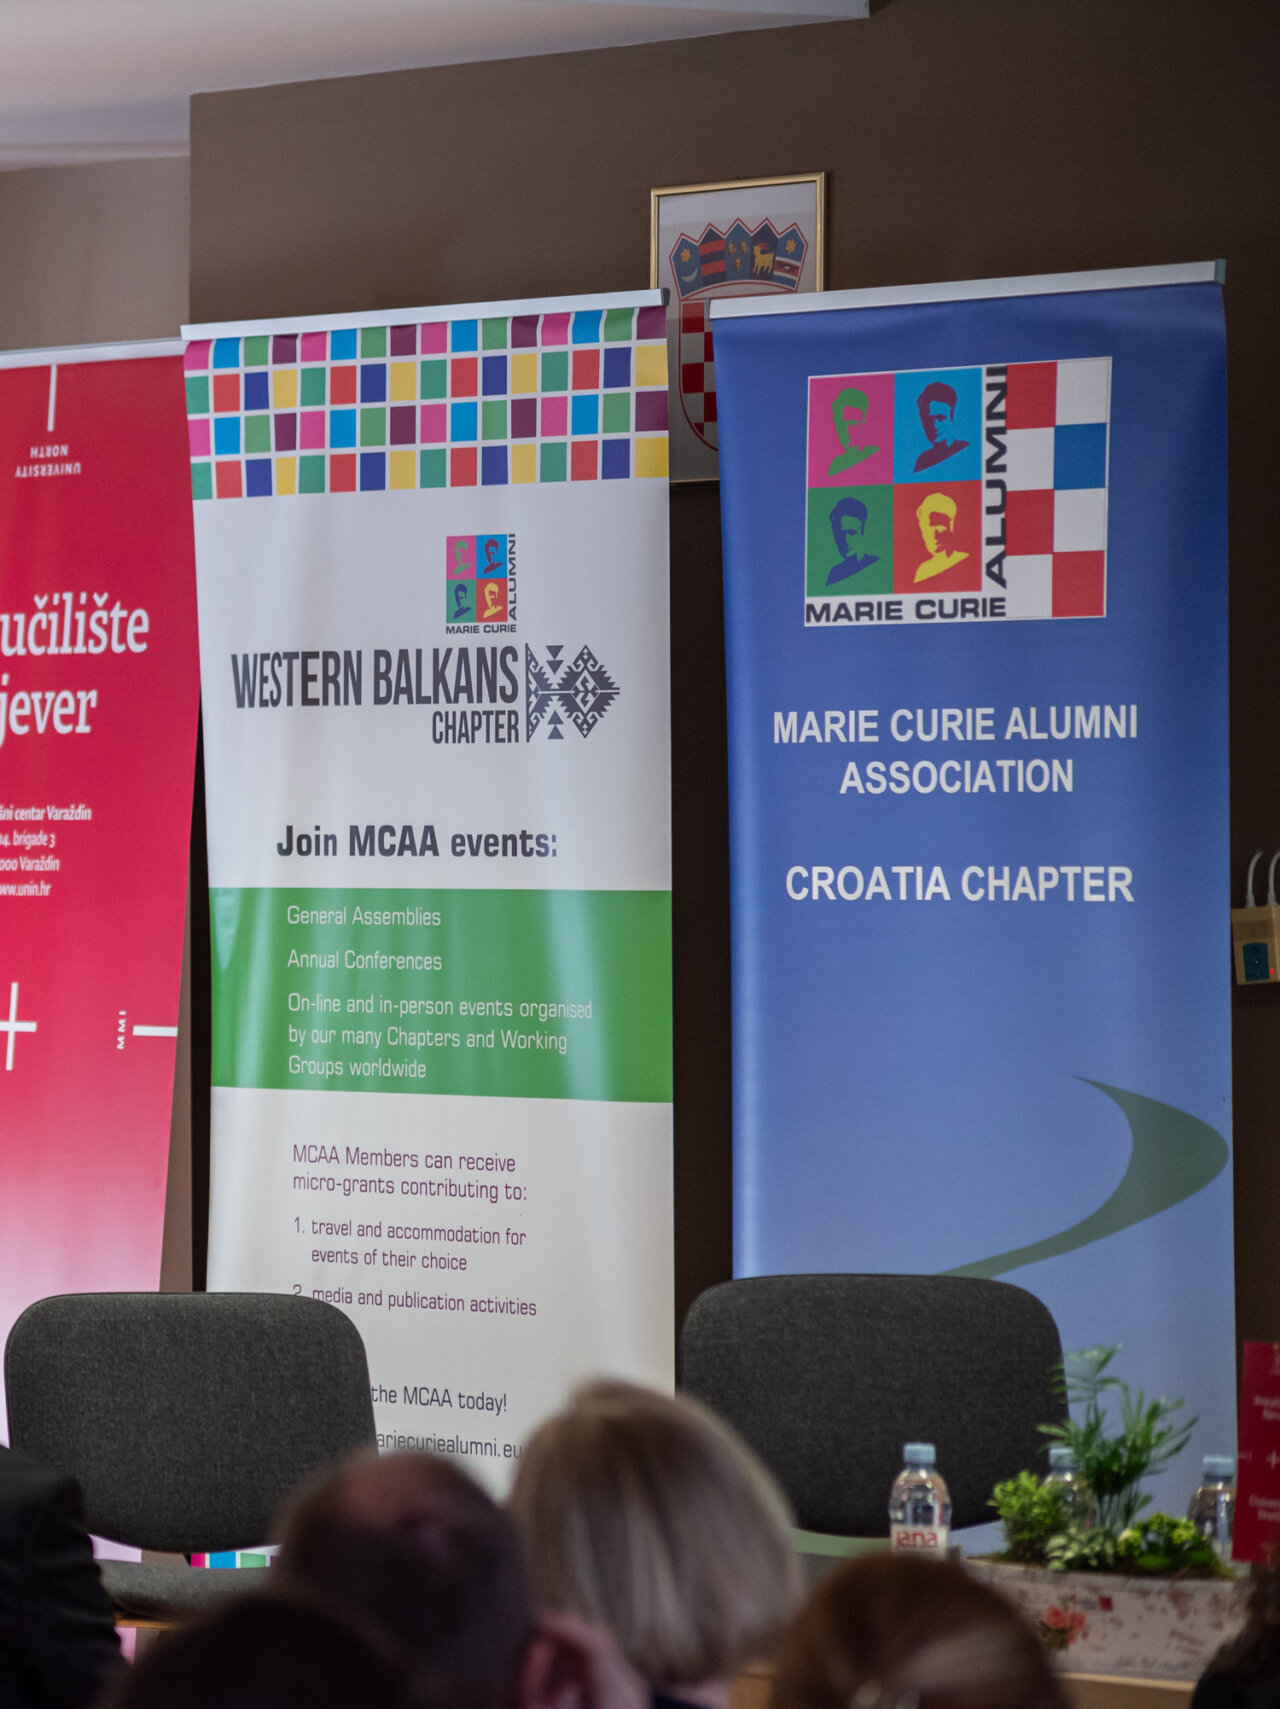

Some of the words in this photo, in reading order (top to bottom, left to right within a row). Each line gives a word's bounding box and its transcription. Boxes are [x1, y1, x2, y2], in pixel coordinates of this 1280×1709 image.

[30, 445, 68, 457] NORTH
[15, 462, 80, 476] UNIVERSITY
[985, 365, 1007, 587] ALUMNI
[508, 534, 516, 620] ALUMNI
[805, 600, 902, 622] MARIE
[914, 597, 1006, 619] CURIE
[446, 625, 479, 633] MARIE
[483, 624, 516, 632] CURIE
[231, 650, 362, 708] WESTERN
[373, 645, 518, 705] BALKANS
[432, 710, 519, 744] CHAPTER
[773, 710, 878, 742] MARIE
[890, 707, 995, 741] CURIE
[1004, 704, 1137, 740] ALUMNI
[839, 758, 1073, 794] ASSOCIATION
[14, 806, 45, 820] centar
[47, 804, 91, 820] Varaždin
[13, 830, 47, 849] brigade
[49, 833, 55, 847] 3
[276, 825, 337, 856] Join
[348, 825, 439, 856] MCAA
[450, 829, 557, 857] events:
[19, 855, 59, 870] Varaždin
[786, 865, 950, 900] CROATIA
[961, 865, 1134, 901] CHAPTER
[287, 905, 346, 924] General
[352, 906, 440, 925] Assemblies
[287, 949, 338, 968] Annual
[344, 950, 441, 970] Conferences
[288, 993, 340, 1011] On-line
[346, 994, 373, 1012] and
[380, 995, 452, 1017] in-person
[459, 1000, 512, 1016] events
[519, 999, 592, 1021] organised
[289, 1024, 305, 1046] by
[311, 1027, 335, 1043] our
[341, 1029, 381, 1048] many
[387, 1026, 460, 1050] Chapters
[466, 1029, 494, 1047] and
[501, 1030, 566, 1054] Working
[289, 1055, 343, 1078] Groups
[349, 1058, 425, 1077] worldwide
[293, 1144, 339, 1163] MCAA
[345, 1146, 418, 1167] Members
[424, 1153, 452, 1168] can
[458, 1153, 515, 1172] receive
[293, 1171, 394, 1196] micro-grants
[400, 1178, 498, 1203] contributing
[504, 1181, 526, 1200] to:
[294, 1217, 304, 1234] 1.
[311, 1219, 351, 1235] travel
[357, 1221, 381, 1237] and
[387, 1223, 499, 1244] accommodation
[505, 1228, 526, 1245] for
[311, 1249, 357, 1264] events
[363, 1248, 377, 1265] of
[381, 1250, 416, 1267] their
[421, 1252, 467, 1270] choice
[312, 1286, 352, 1303] media
[357, 1288, 382, 1305] and
[388, 1291, 464, 1310] publication
[470, 1296, 537, 1315] activities
[371, 1384, 396, 1403] the
[403, 1386, 452, 1407] MCAA
[458, 1393, 506, 1415] today!
[377, 1429, 522, 1459] ariecuriealumni.eu
